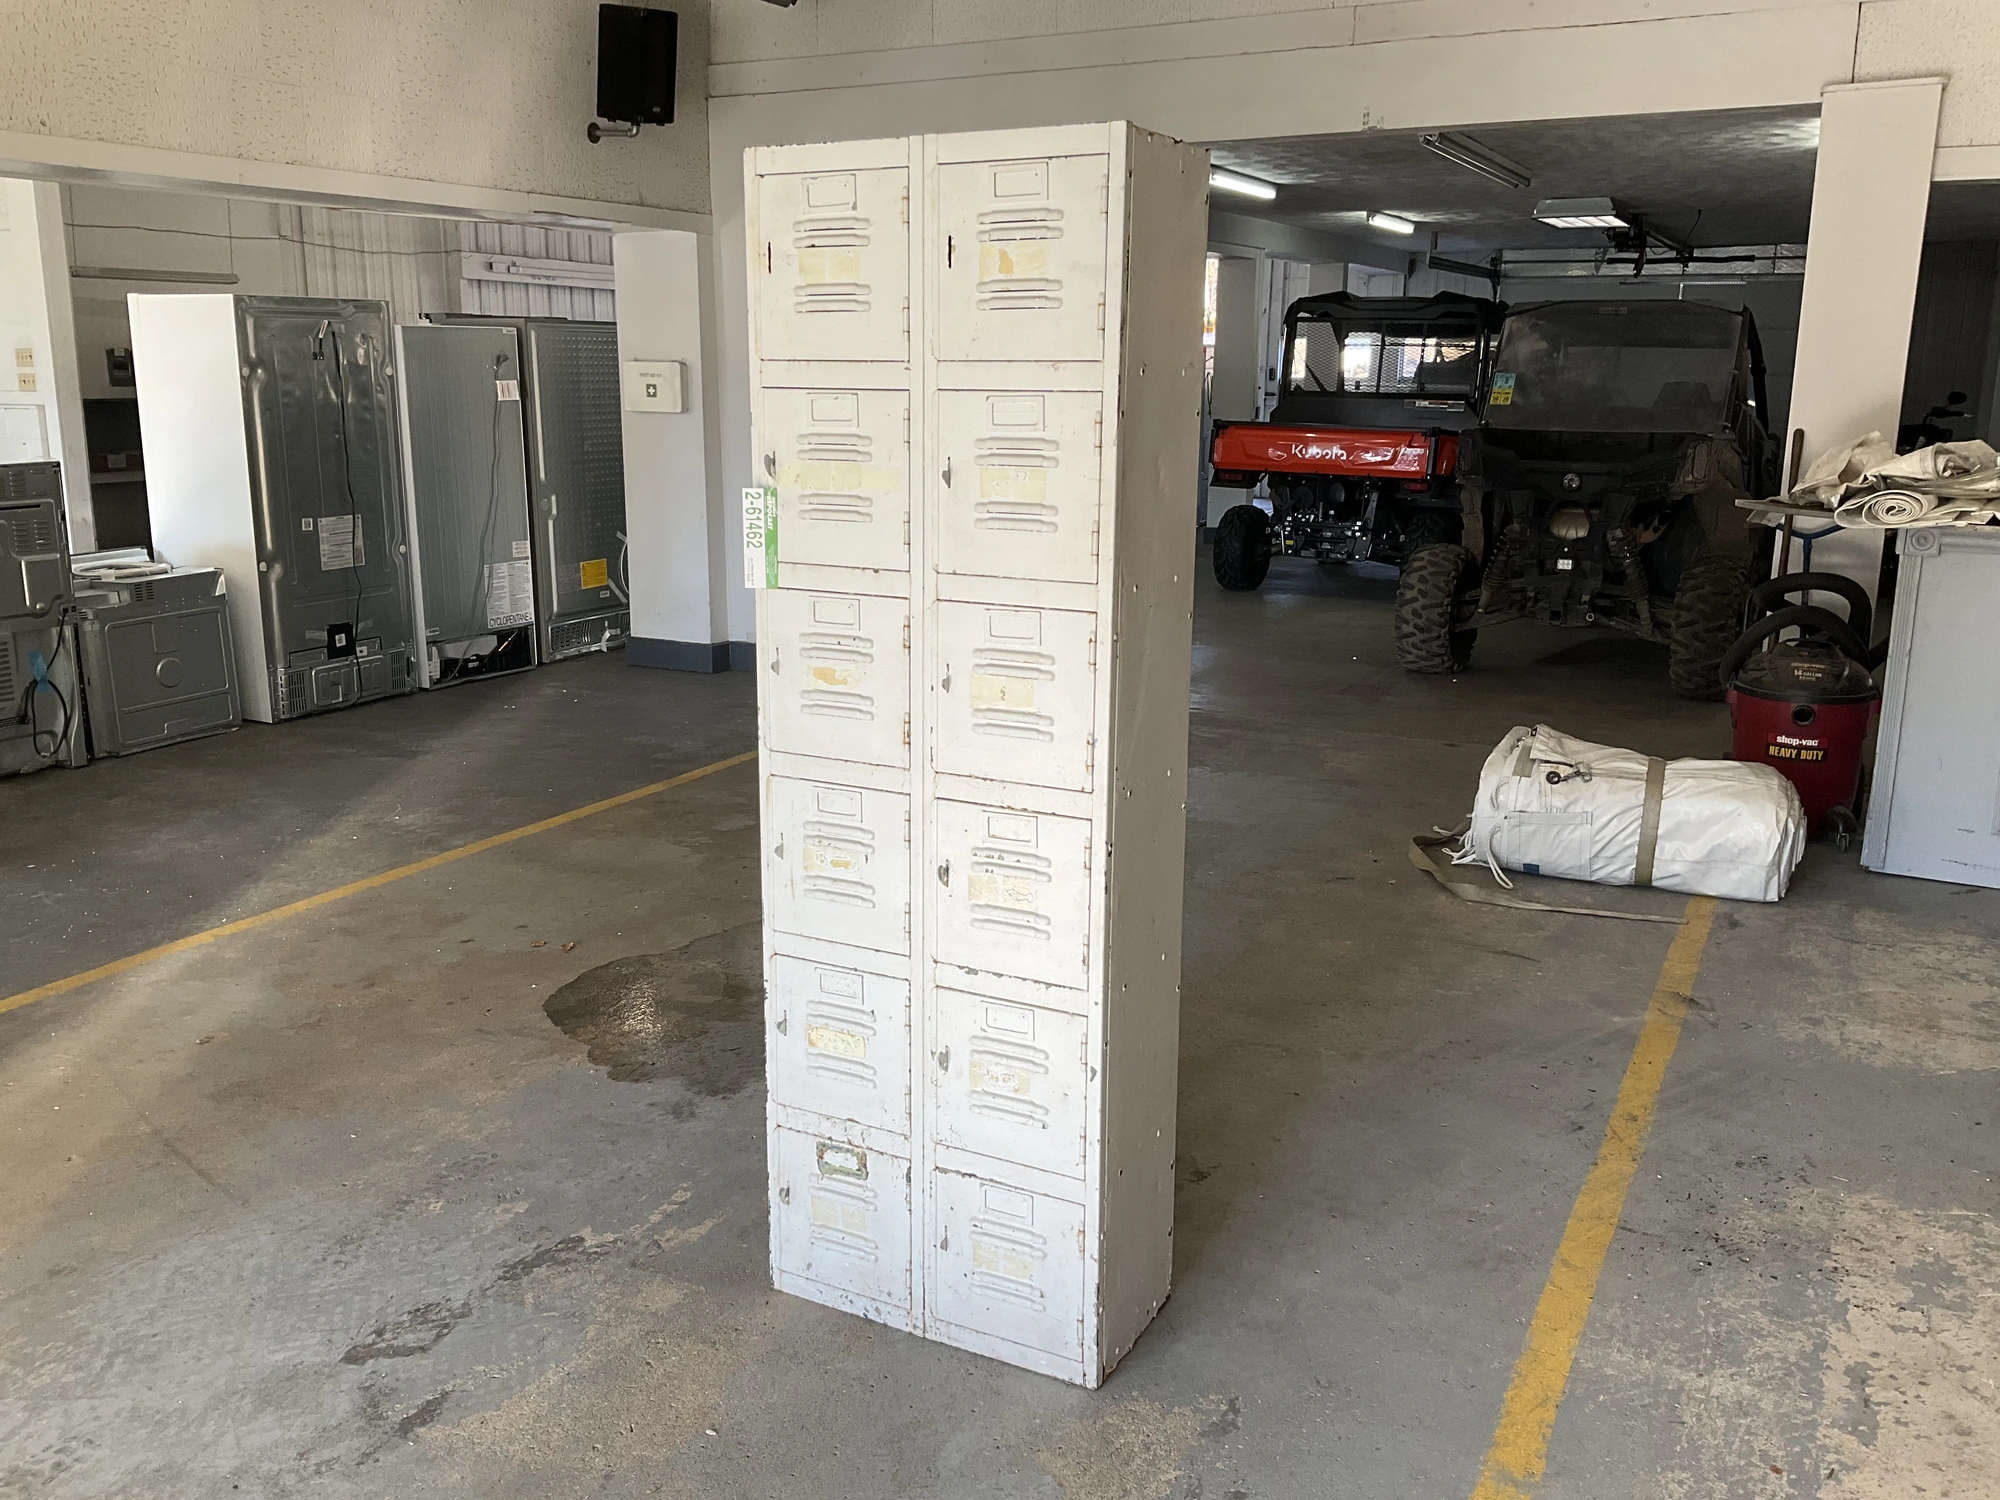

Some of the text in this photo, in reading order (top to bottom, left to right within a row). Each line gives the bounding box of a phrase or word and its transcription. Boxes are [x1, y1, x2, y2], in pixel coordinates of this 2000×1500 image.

[1291, 443, 1347, 461] Kubota
[745, 491, 763, 548] 2-61462
[489, 612, 529, 627] CYCLOPENTANE
[1769, 745, 1824, 760] HEAVY DUTY
